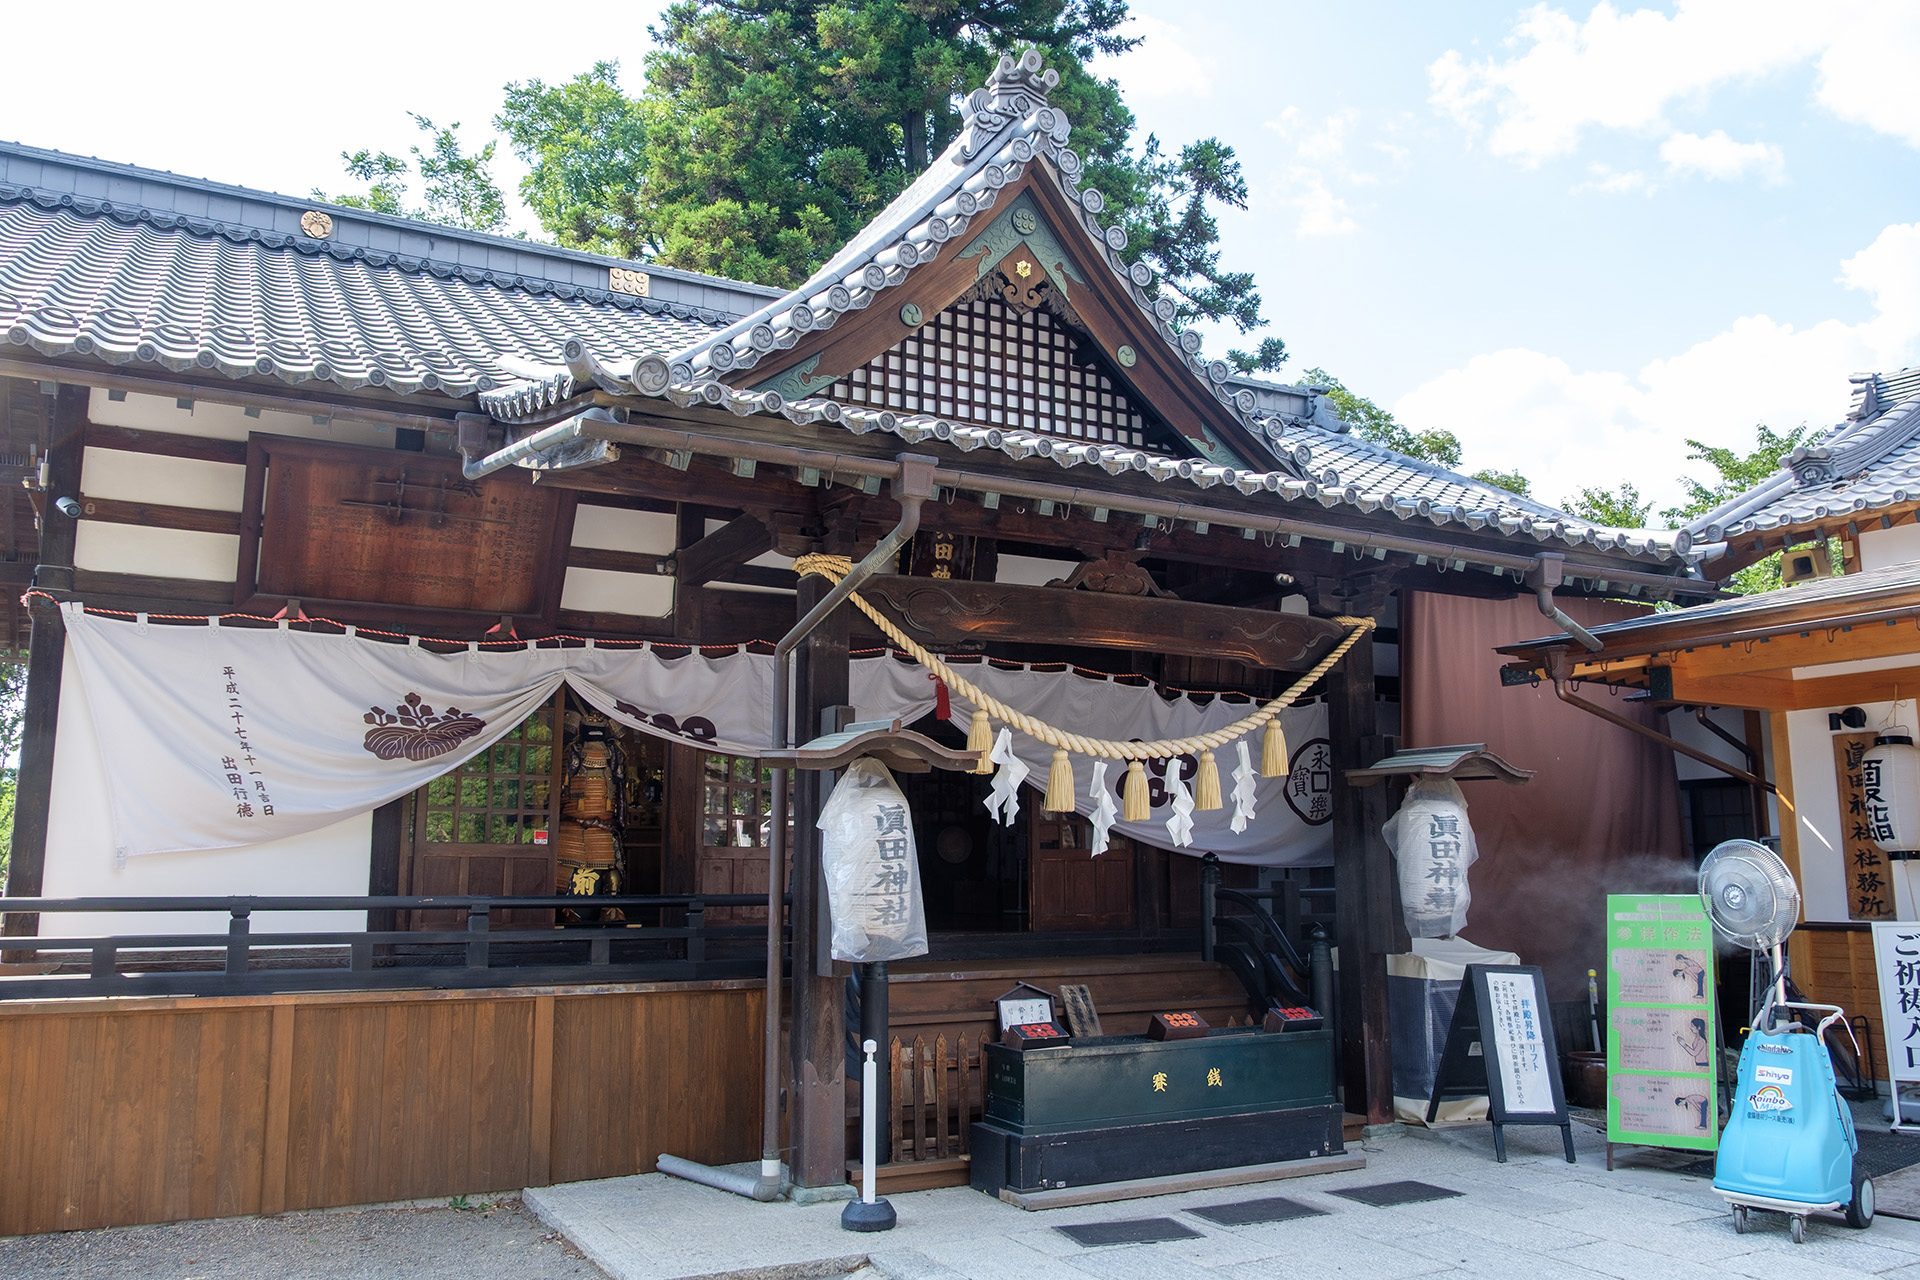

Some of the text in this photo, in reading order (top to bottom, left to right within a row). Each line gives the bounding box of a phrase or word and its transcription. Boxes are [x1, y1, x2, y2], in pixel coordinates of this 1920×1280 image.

[221, 755, 255, 818] 出田行徳
[222, 666, 274, 817] 平成二十七年十一月吉日
[870, 803, 909, 926] 眞田神社
[1424, 813, 1462, 910] 眞田神社
[1616, 926, 1703, 941] 参拝作法
